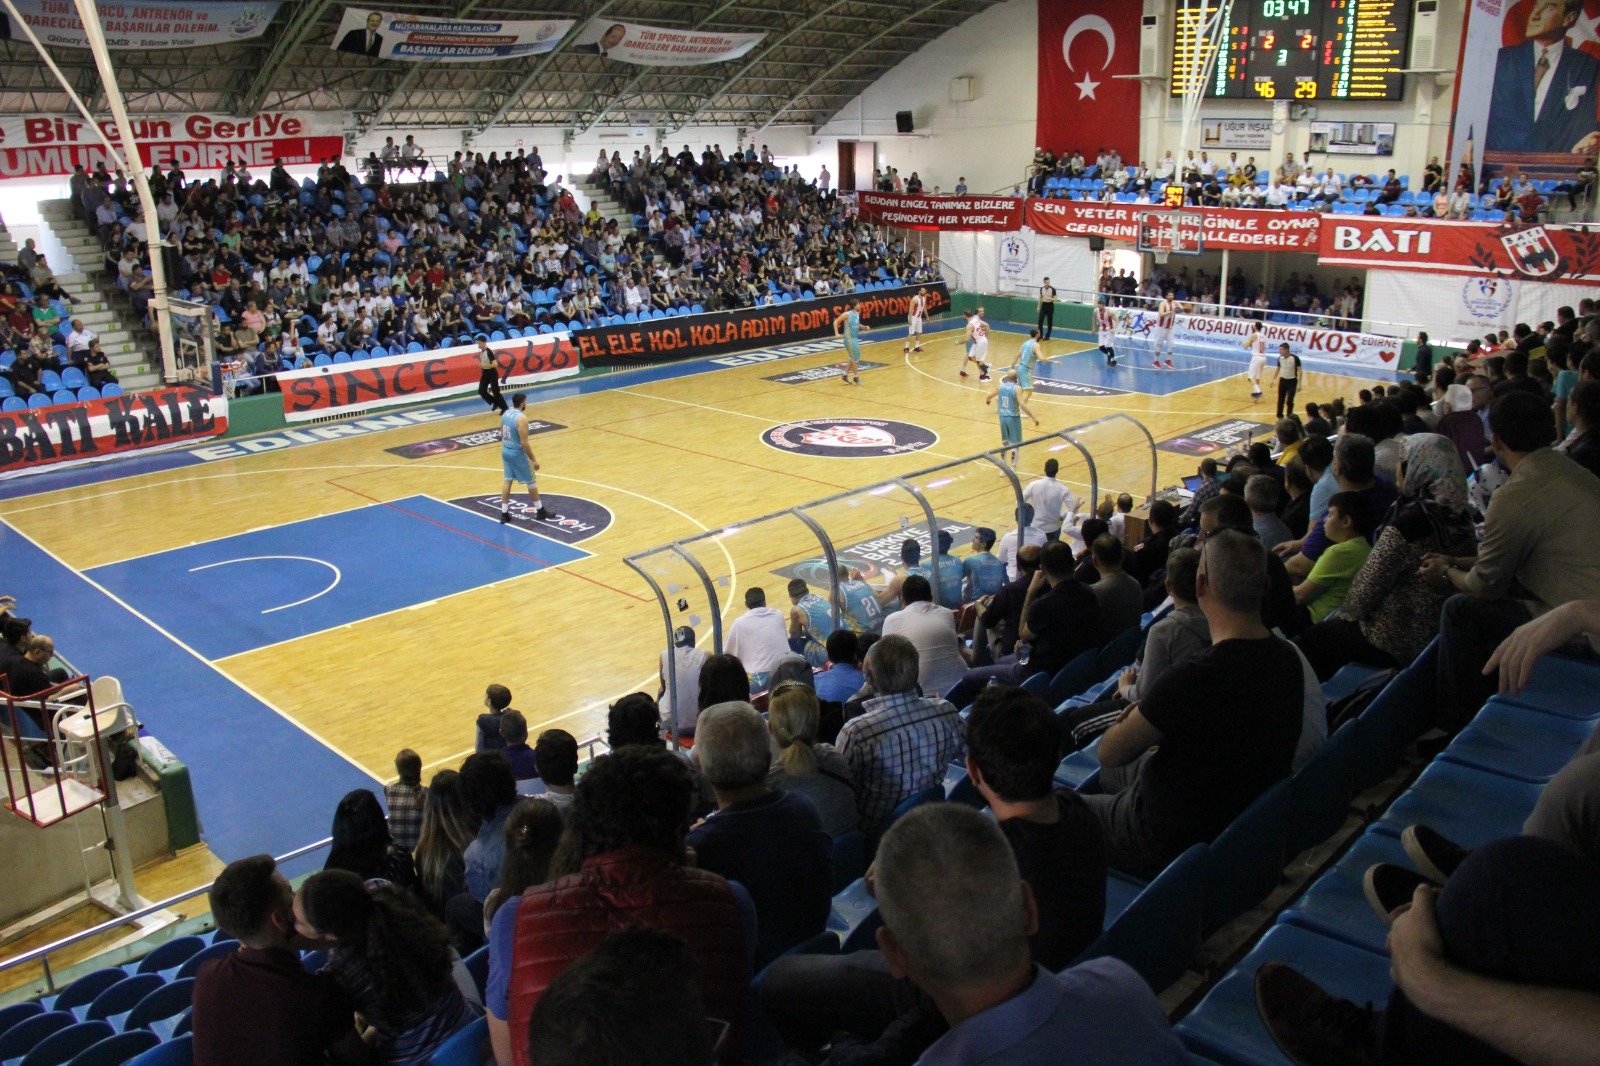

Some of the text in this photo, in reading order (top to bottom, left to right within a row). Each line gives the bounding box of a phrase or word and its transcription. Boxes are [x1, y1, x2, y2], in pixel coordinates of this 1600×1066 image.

[106, 21, 170, 34] BAŞARILAR
[1264, 35, 1275, 49] 2
[1301, 34, 1312, 49] 2
[400, 44, 456, 56] BAŞARILAR
[1278, 49, 1288, 62] 3
[1254, 82, 1275, 98] 46
[1295, 81, 1317, 98] 29
[25, 117, 83, 144] Bir
[900, 200, 929, 210] ENGEL
[930, 201, 971, 210] TANIMAZ
[974, 199, 1015, 210] BİZLERE
[1166, 194, 1182, 206] 24
[882, 212, 934, 224] PEŞİNDEYİZ
[938, 215, 958, 224] HER
[1034, 202, 1066, 215] SEN
[1074, 207, 1128, 220] YETER
[1267, 217, 1320, 230] OYNA
[1065, 222, 1138, 237] GERİSİNİ
[1334, 226, 1432, 255] BATI
[578, 335, 606, 358] EL
[607, 332, 645, 355] ELE
[648, 327, 688, 351] KOL
[690, 321, 738, 346] KOLA
[740, 315, 786, 339] ADIM
[791, 307, 830, 332] ADIM
[1308, 331, 1360, 357] KOŞ
[474, 336, 570, 384] 966
[0, 390, 216, 466] BATI KALE
